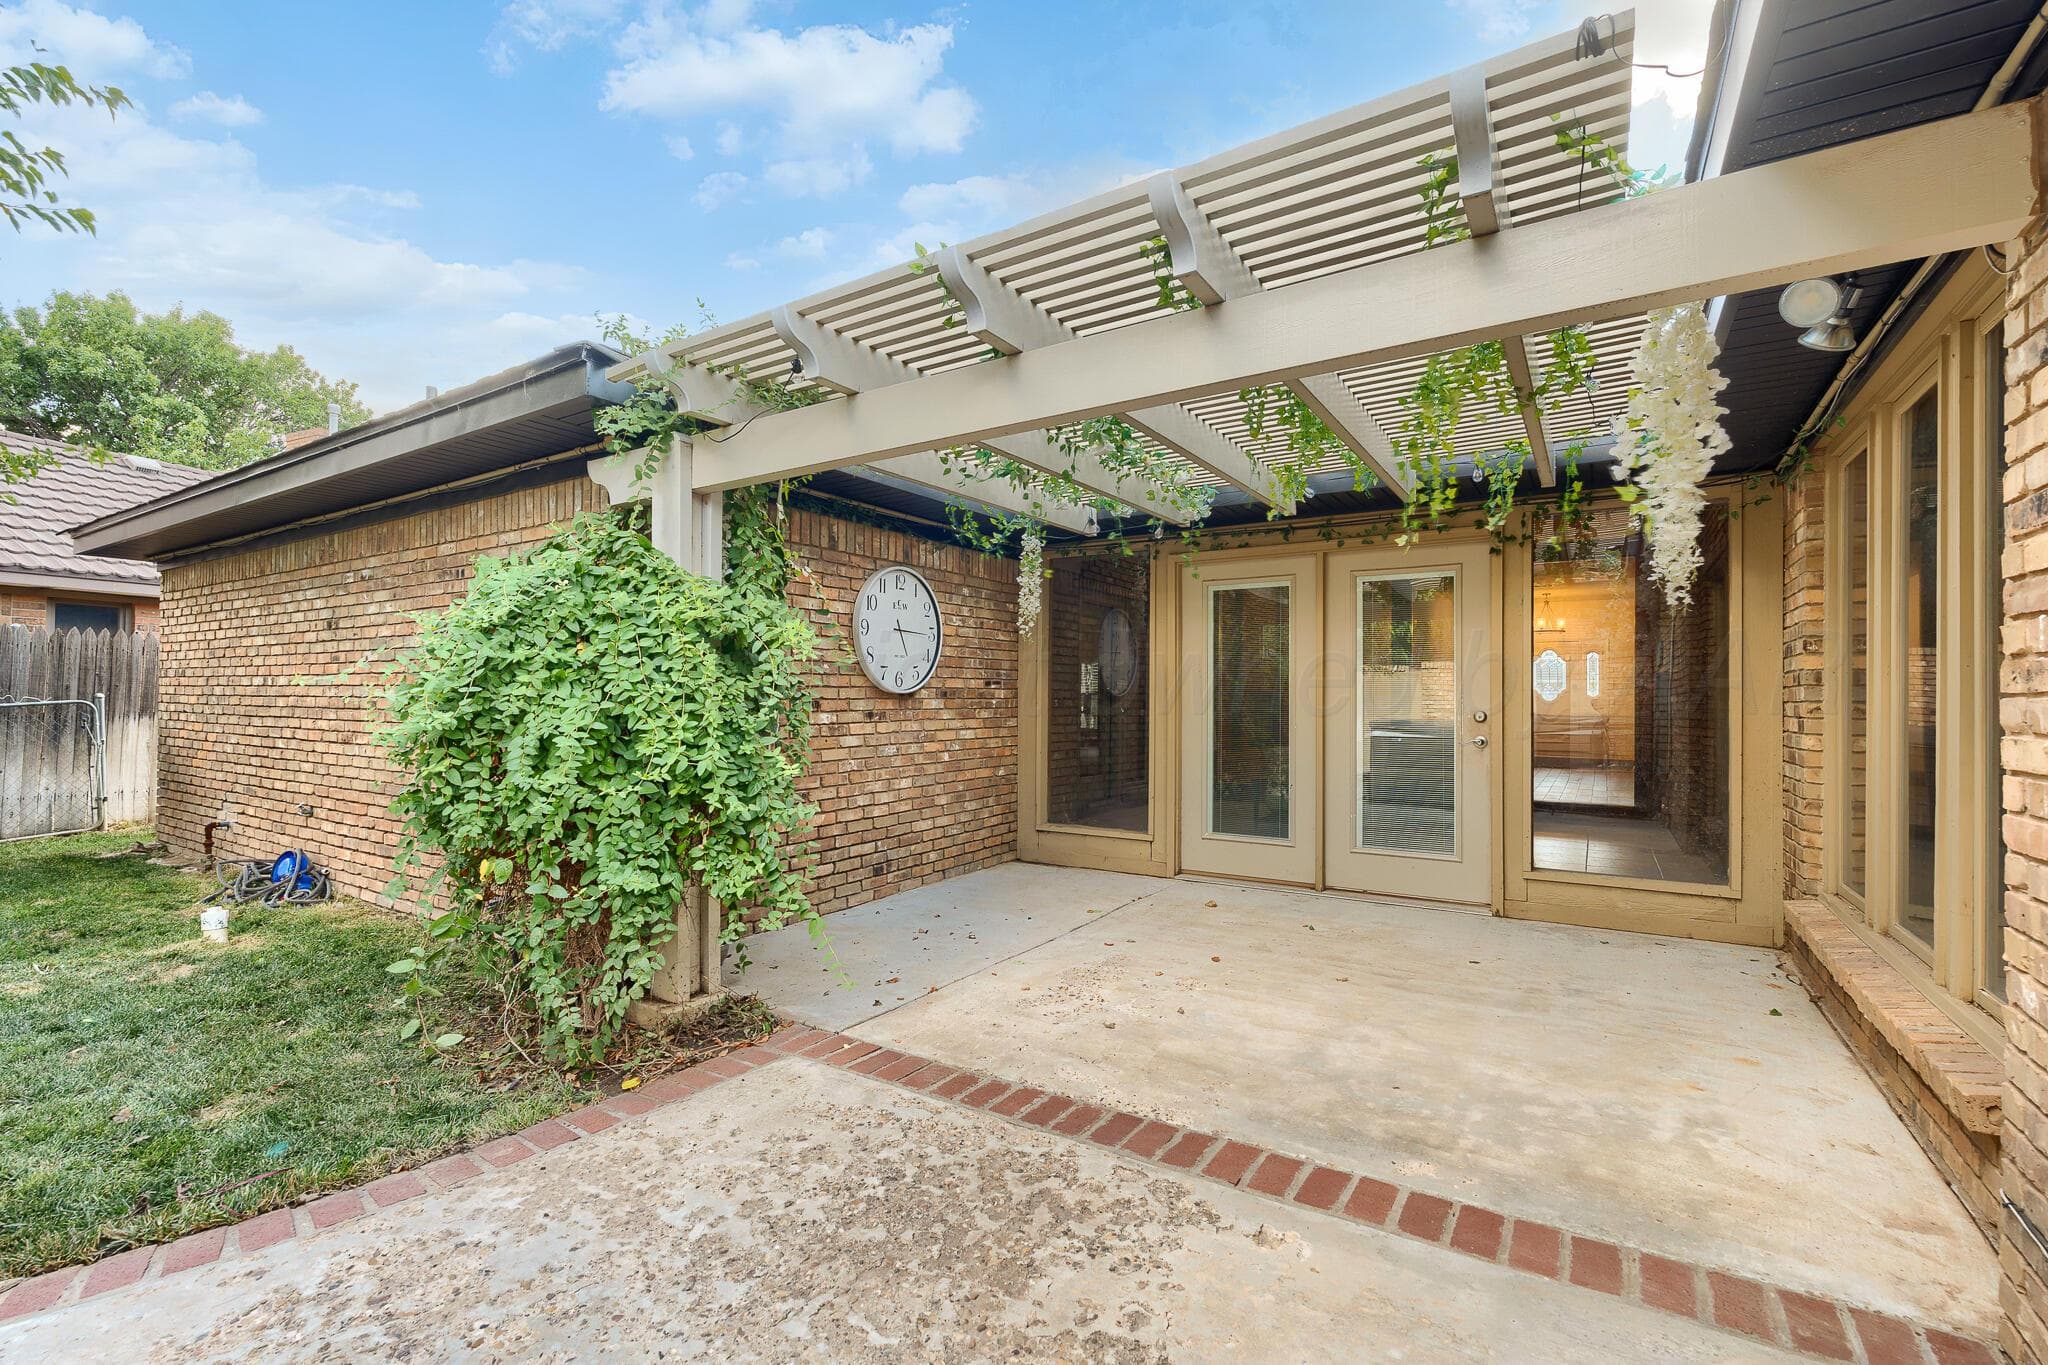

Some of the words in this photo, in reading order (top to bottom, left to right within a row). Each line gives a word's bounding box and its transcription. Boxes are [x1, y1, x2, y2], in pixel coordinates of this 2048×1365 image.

[879, 577, 886, 593] 11
[895, 574, 906, 590] 12
[866, 594, 878, 611] 10
[923, 601, 931, 618] 2
[860, 618, 870, 636] 9
[928, 627, 936, 643] 3
[866, 646, 875, 664] 8
[922, 648, 932, 663] 4
[880, 665, 889, 681] 7
[895, 671, 904, 688] 6
[912, 665, 920, 681] 5
